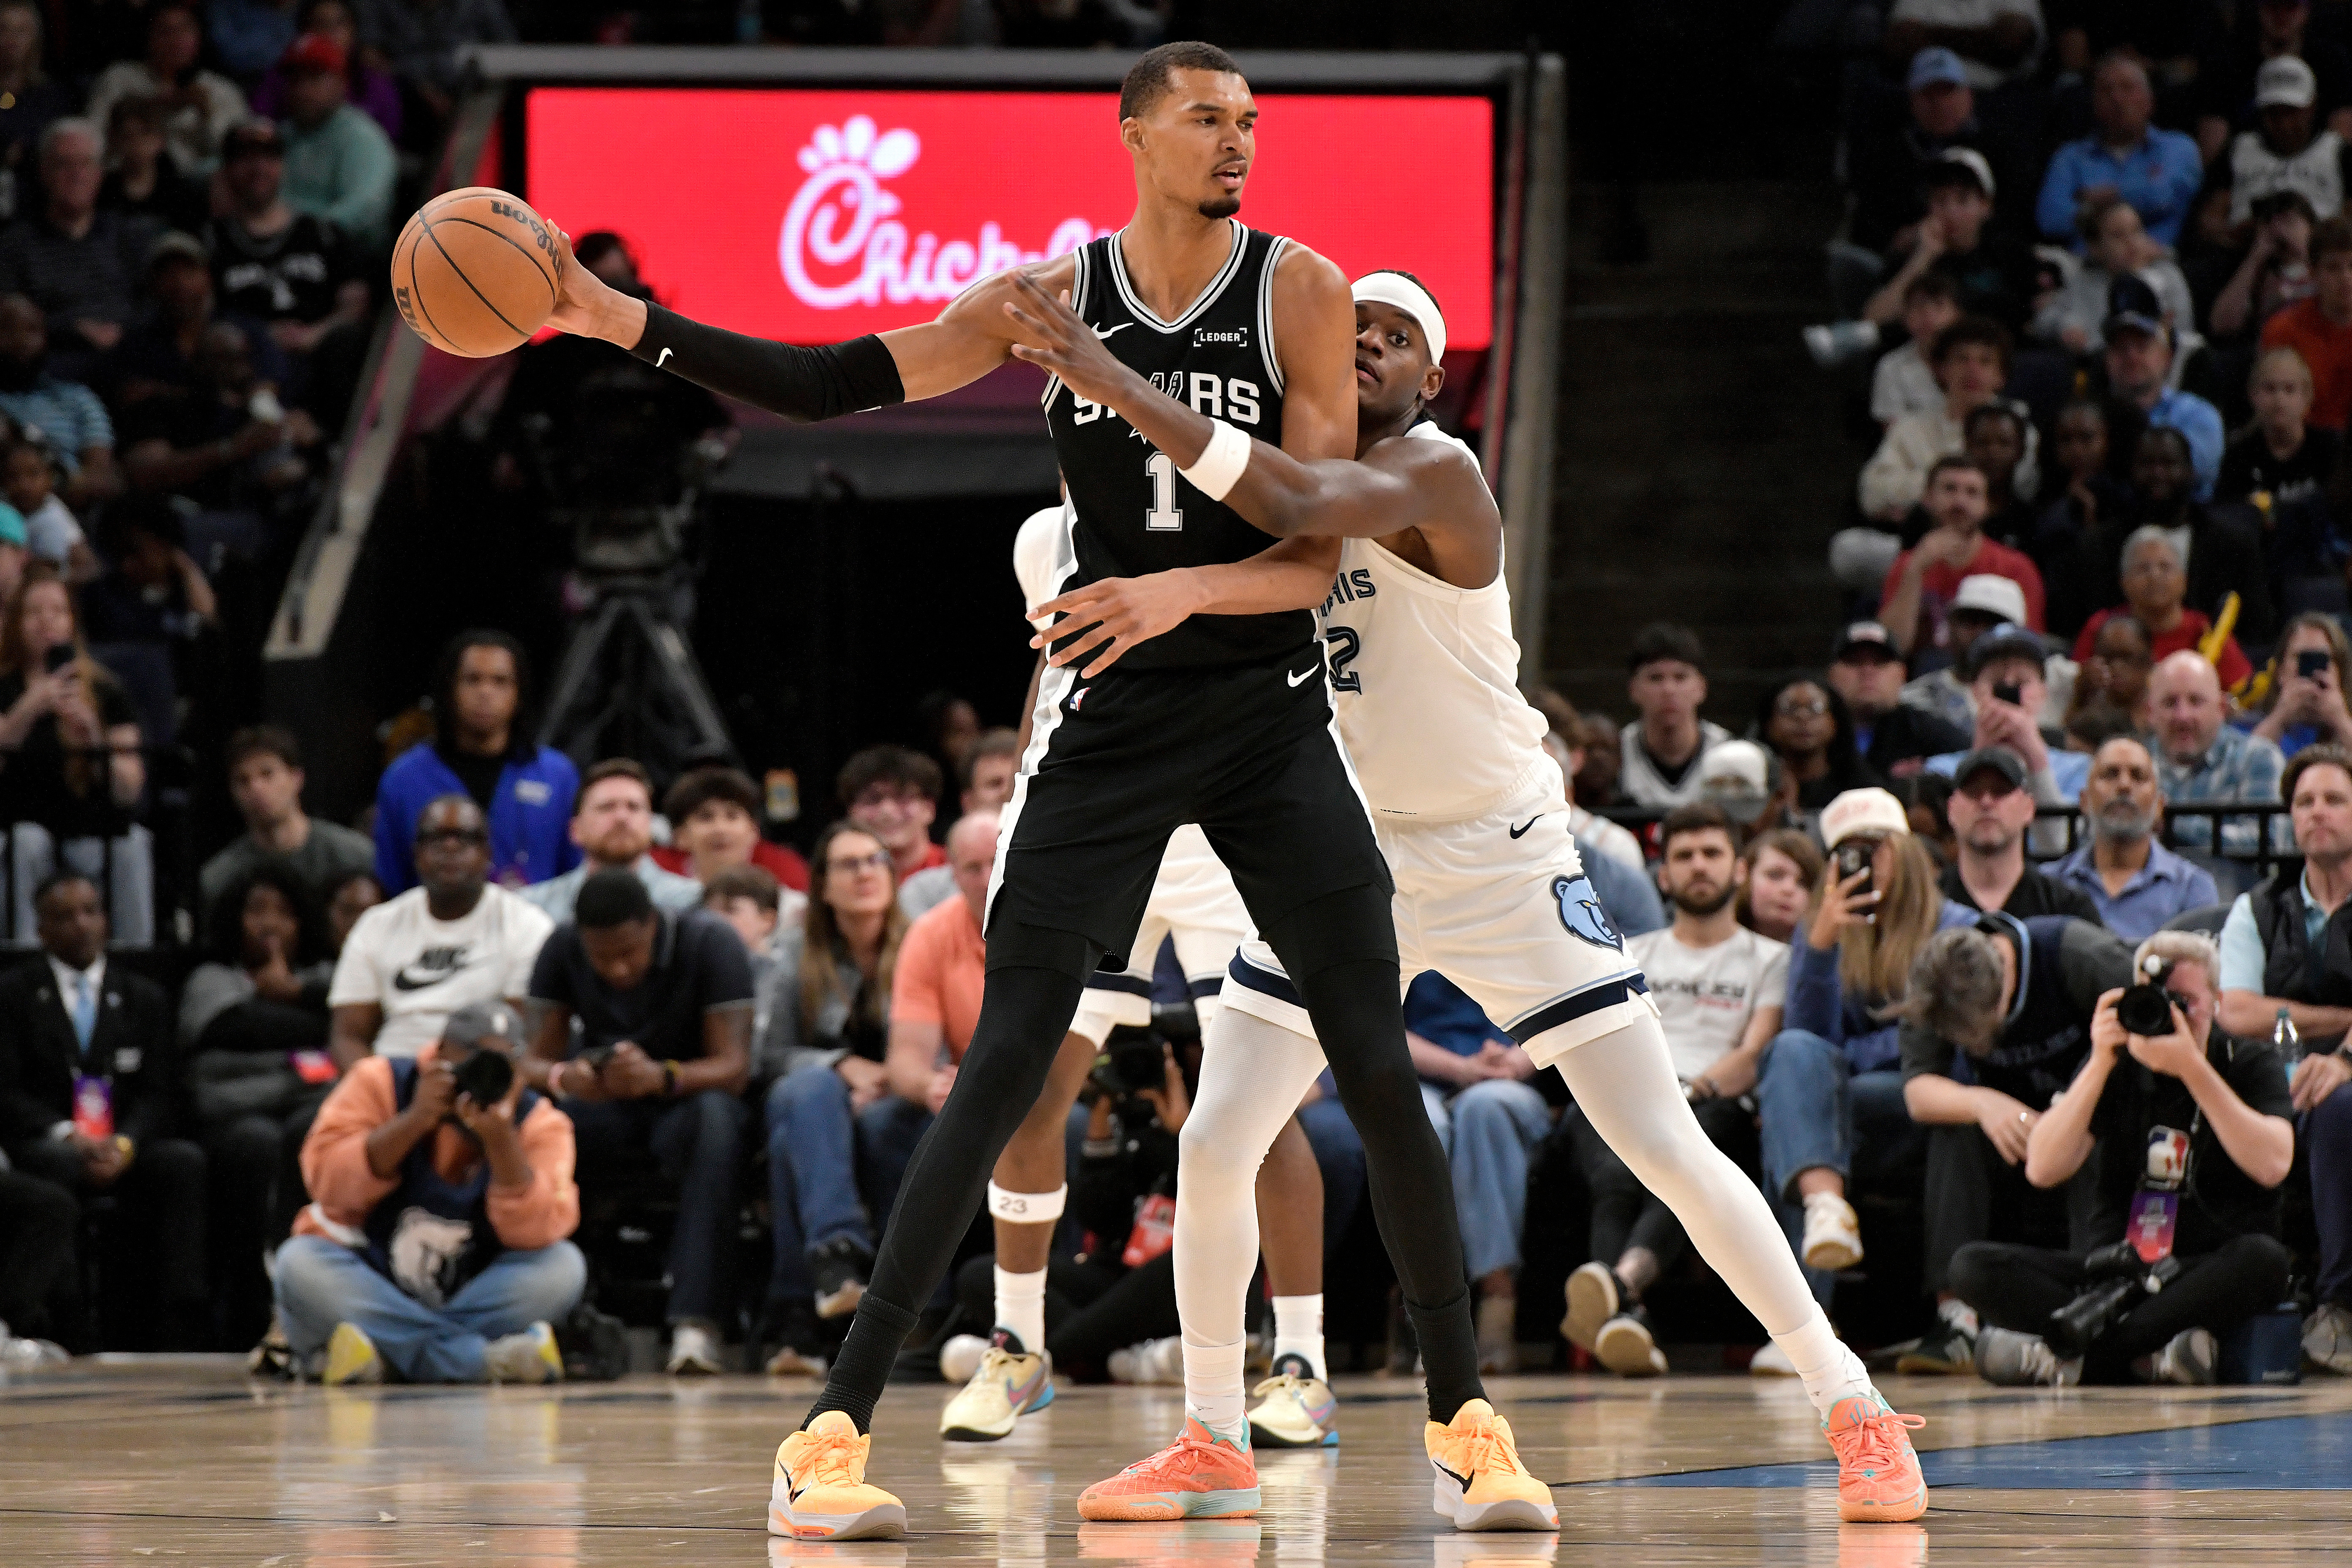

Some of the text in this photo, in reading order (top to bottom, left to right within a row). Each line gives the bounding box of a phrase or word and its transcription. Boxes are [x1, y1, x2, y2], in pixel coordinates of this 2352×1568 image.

[1200, 332, 1241, 342] LEDGER
[1074, 371, 1260, 426] SRS
[1146, 451, 1183, 531] 1
[999, 1196, 1027, 1214] 23
